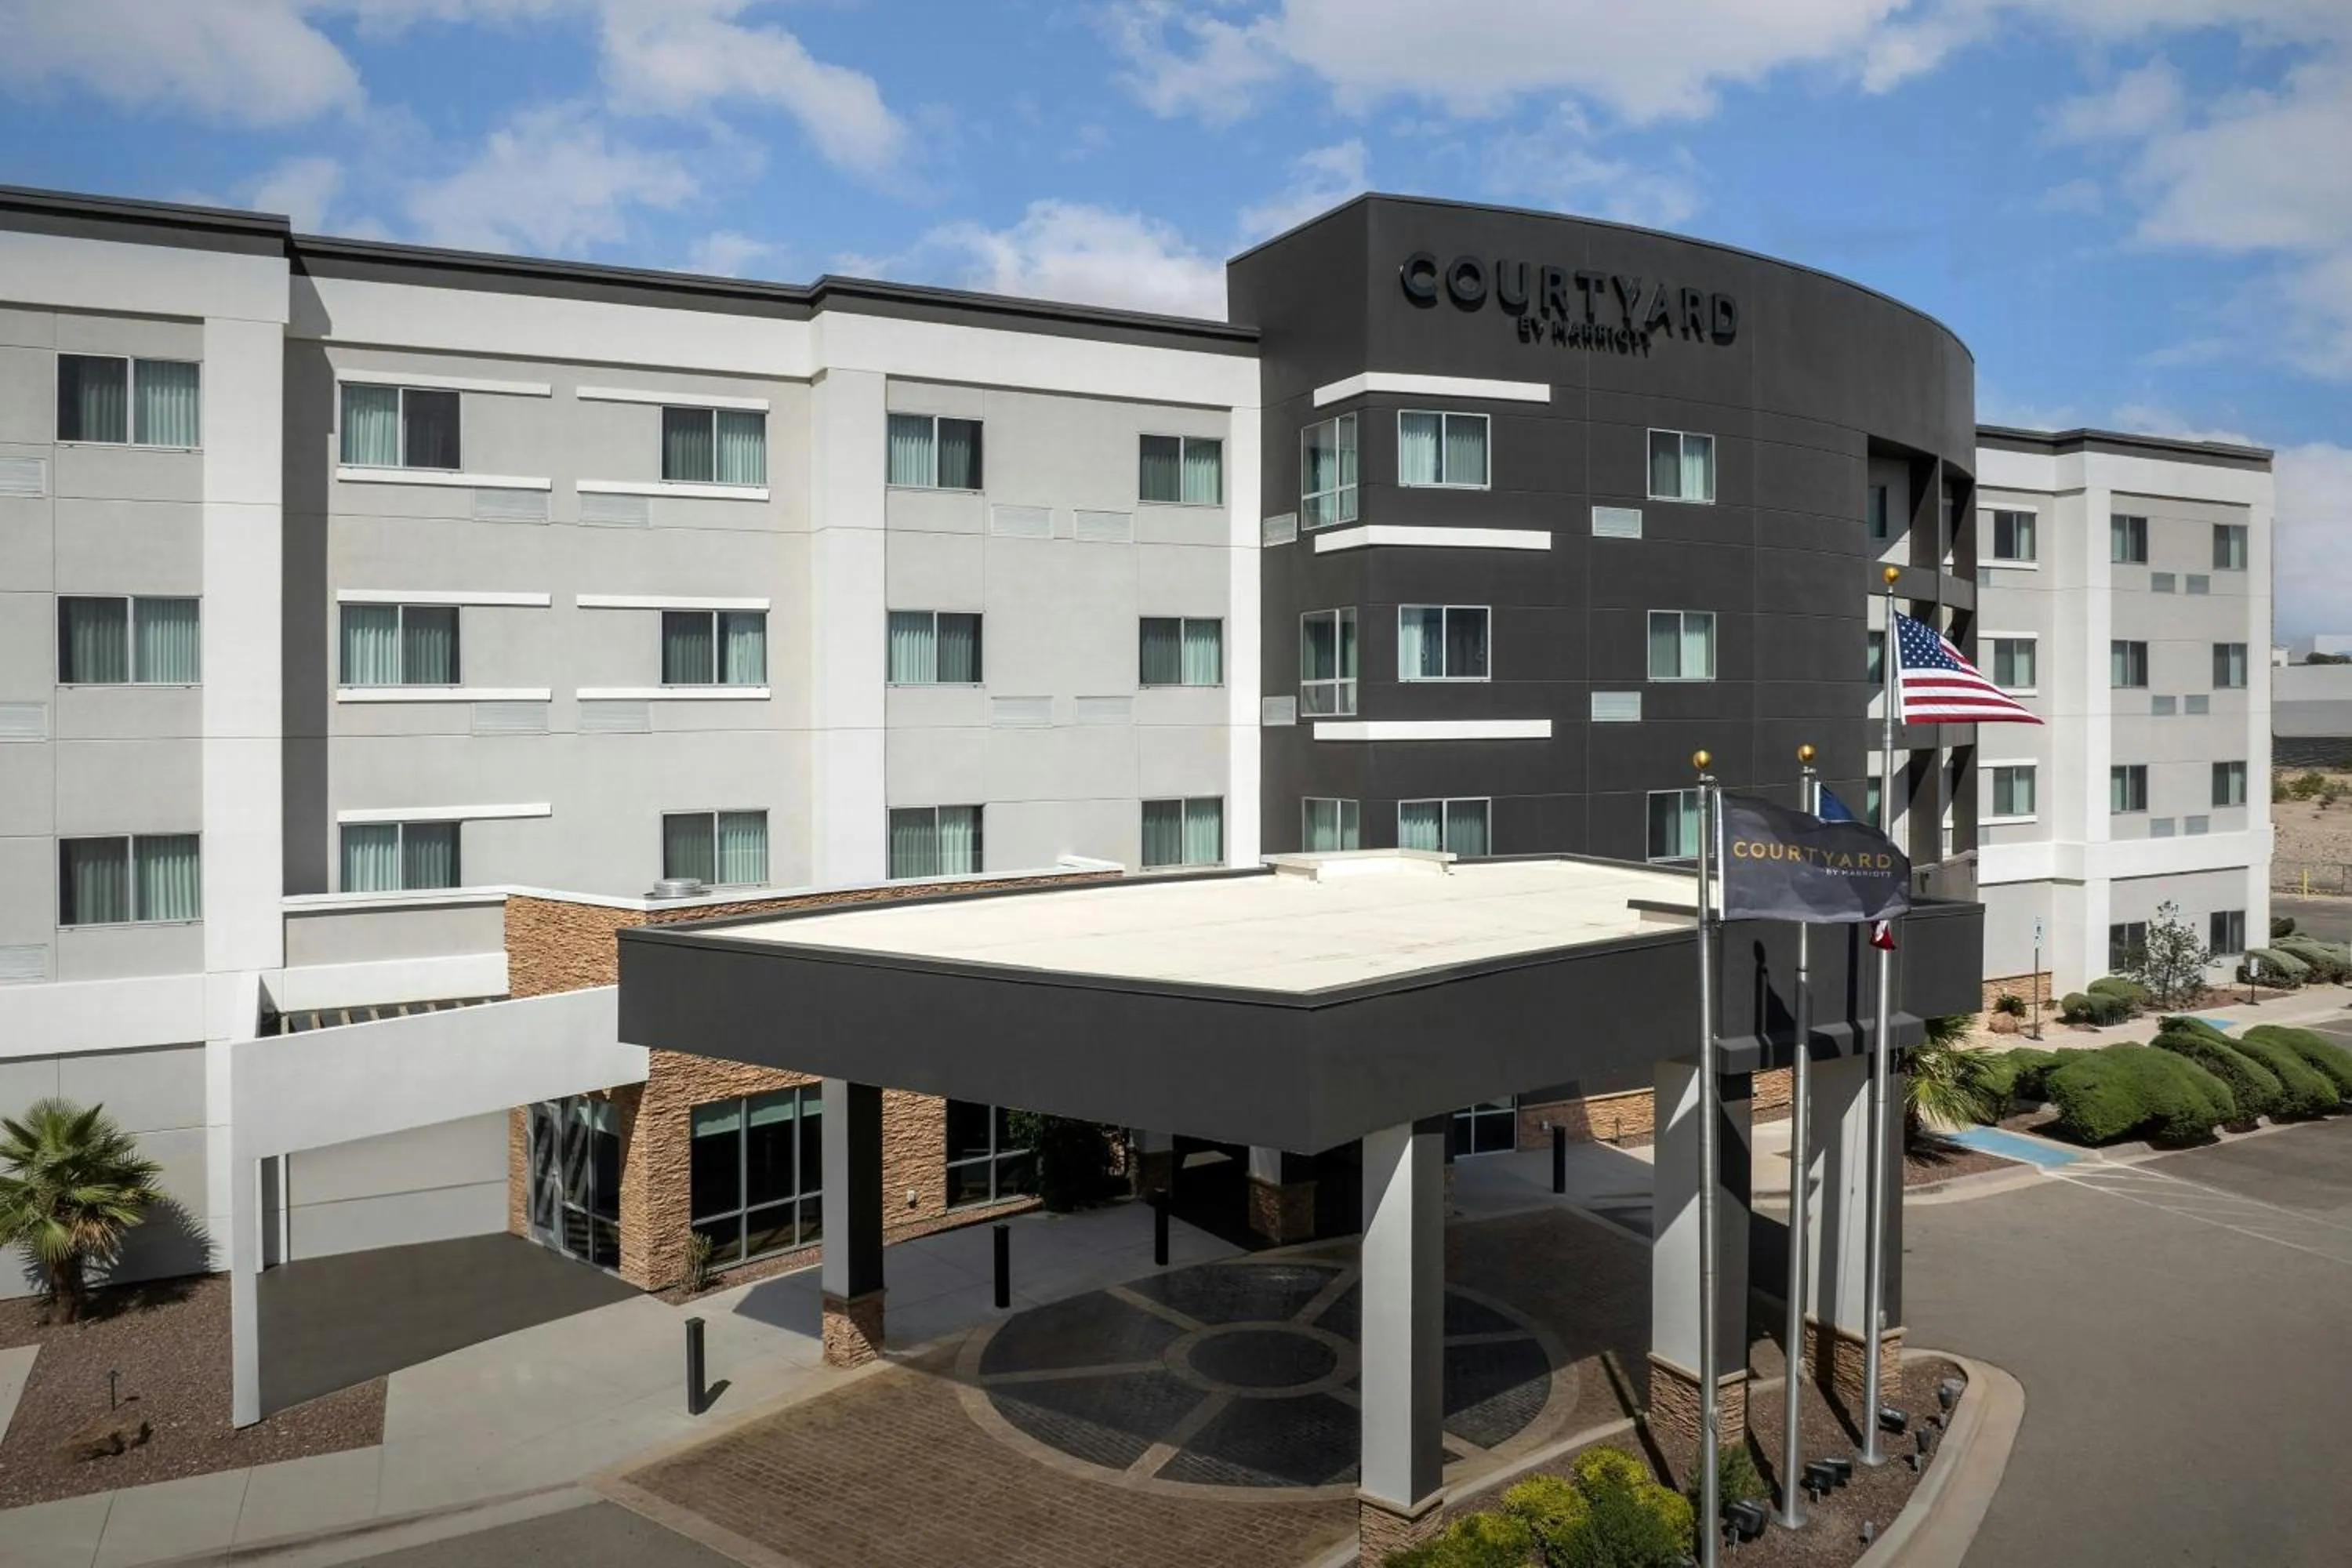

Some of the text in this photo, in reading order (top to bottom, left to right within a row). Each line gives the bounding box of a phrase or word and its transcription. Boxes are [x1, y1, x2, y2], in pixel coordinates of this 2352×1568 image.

[1401, 251, 1738, 342] COURTYARD
[1732, 841, 1893, 869] COURTYARD
[1841, 869, 1893, 879] MARRIOTT
